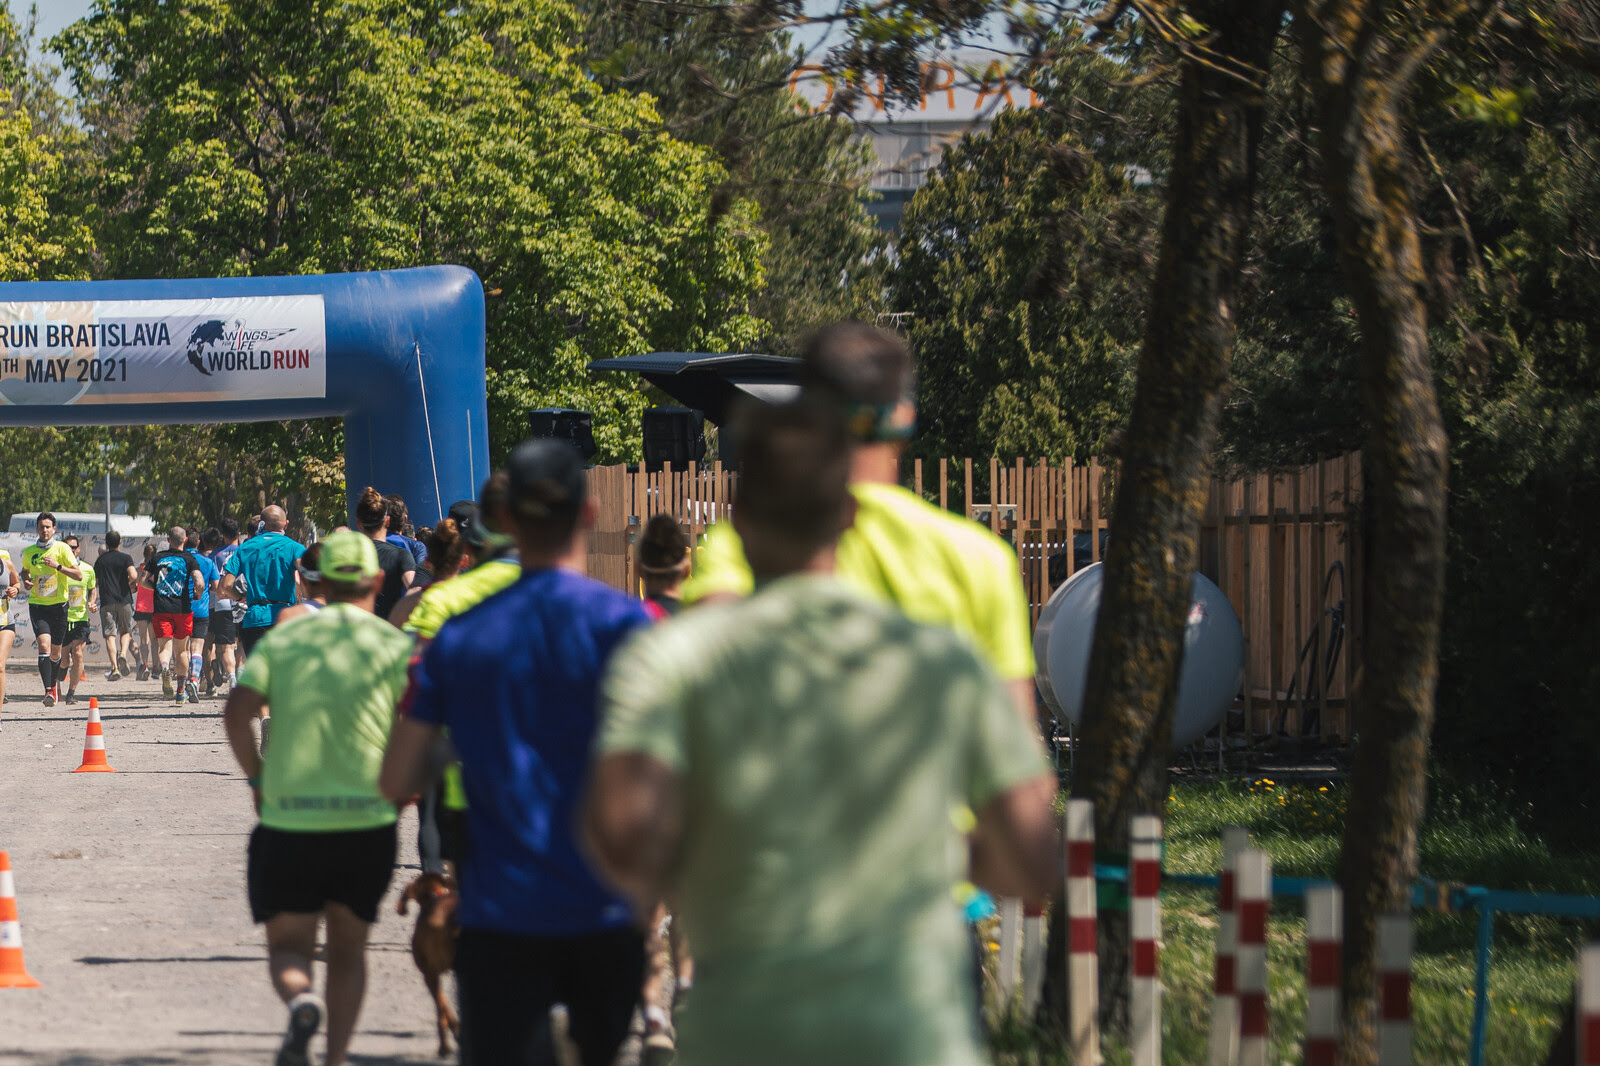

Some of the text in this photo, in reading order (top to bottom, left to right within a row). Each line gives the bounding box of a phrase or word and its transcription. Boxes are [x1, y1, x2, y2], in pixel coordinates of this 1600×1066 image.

[46, 322, 171, 347] BRATISLAVA
[223, 330, 269, 341] WINGS
[230, 340, 257, 351] LIFE
[25, 358, 69, 383] MAY
[76, 357, 127, 383] 2021
